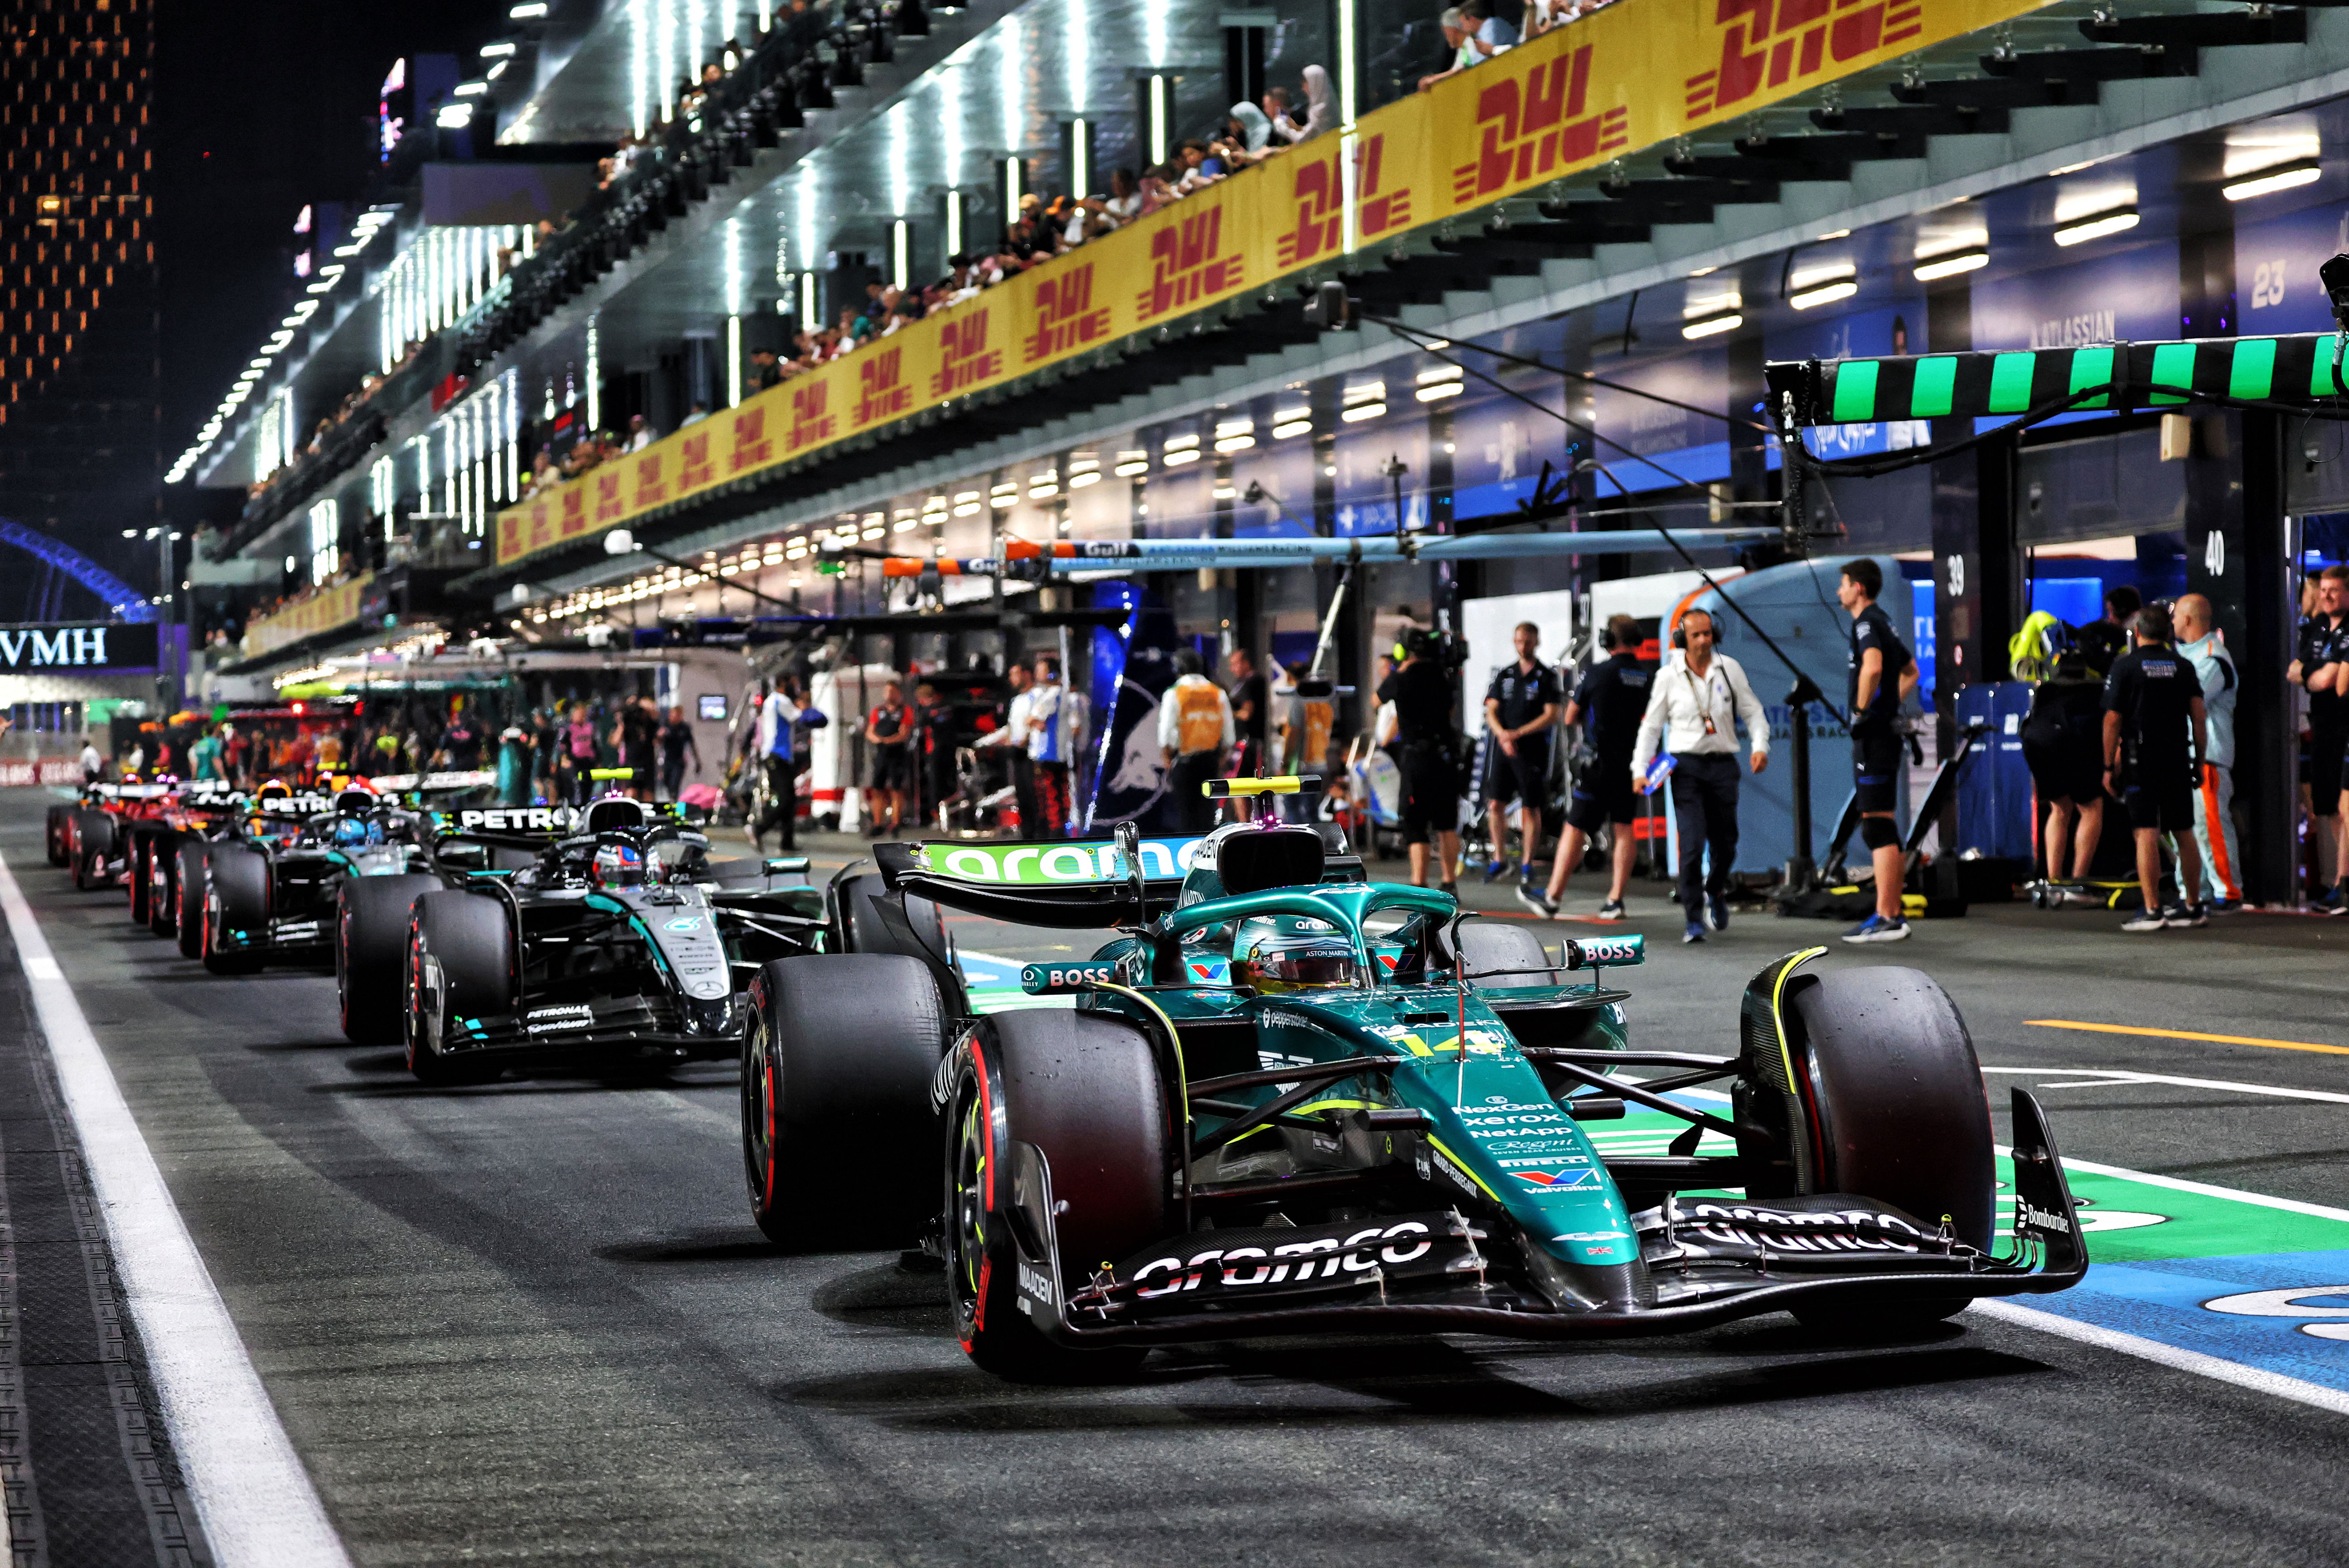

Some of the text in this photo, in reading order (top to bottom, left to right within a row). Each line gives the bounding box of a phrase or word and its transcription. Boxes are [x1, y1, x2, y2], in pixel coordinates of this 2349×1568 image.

[1476, 45, 1603, 196] DHL
[1294, 133, 1391, 262] DHL
[1151, 204, 1228, 316] DHL
[2251, 259, 2286, 310] 23
[1034, 262, 1096, 359] DHL
[939, 307, 991, 396] DHL
[2205, 530, 2225, 577] 40
[1947, 554, 1965, 597] 39
[0, 627, 108, 667] VMH
[461, 802, 656, 830] PETROS
[945, 839, 1204, 881] aram
[1195, 839, 1219, 859] AADEN
[1295, 921, 1334, 930] aram
[1585, 943, 1635, 961] BOSS
[1050, 968, 1109, 986] BOSS
[526, 1004, 590, 1019] PETRONAS
[1271, 1012, 1308, 1029] pepperstone
[1388, 1030, 1507, 1057] 14
[1451, 1103, 1555, 1114] NexGen
[1462, 1114, 1563, 1126] xerox
[1470, 1127, 1573, 1138] NetApp
[1487, 1138, 1575, 1150] Regent
[1496, 1155, 1590, 1168] PIRELLI
[1523, 1185, 1604, 1194] Valvoline
[2028, 1204, 2069, 1234] Bombardier
[1133, 1221, 1432, 1298] aramco
[1019, 1262, 1053, 1305] MAADEN
